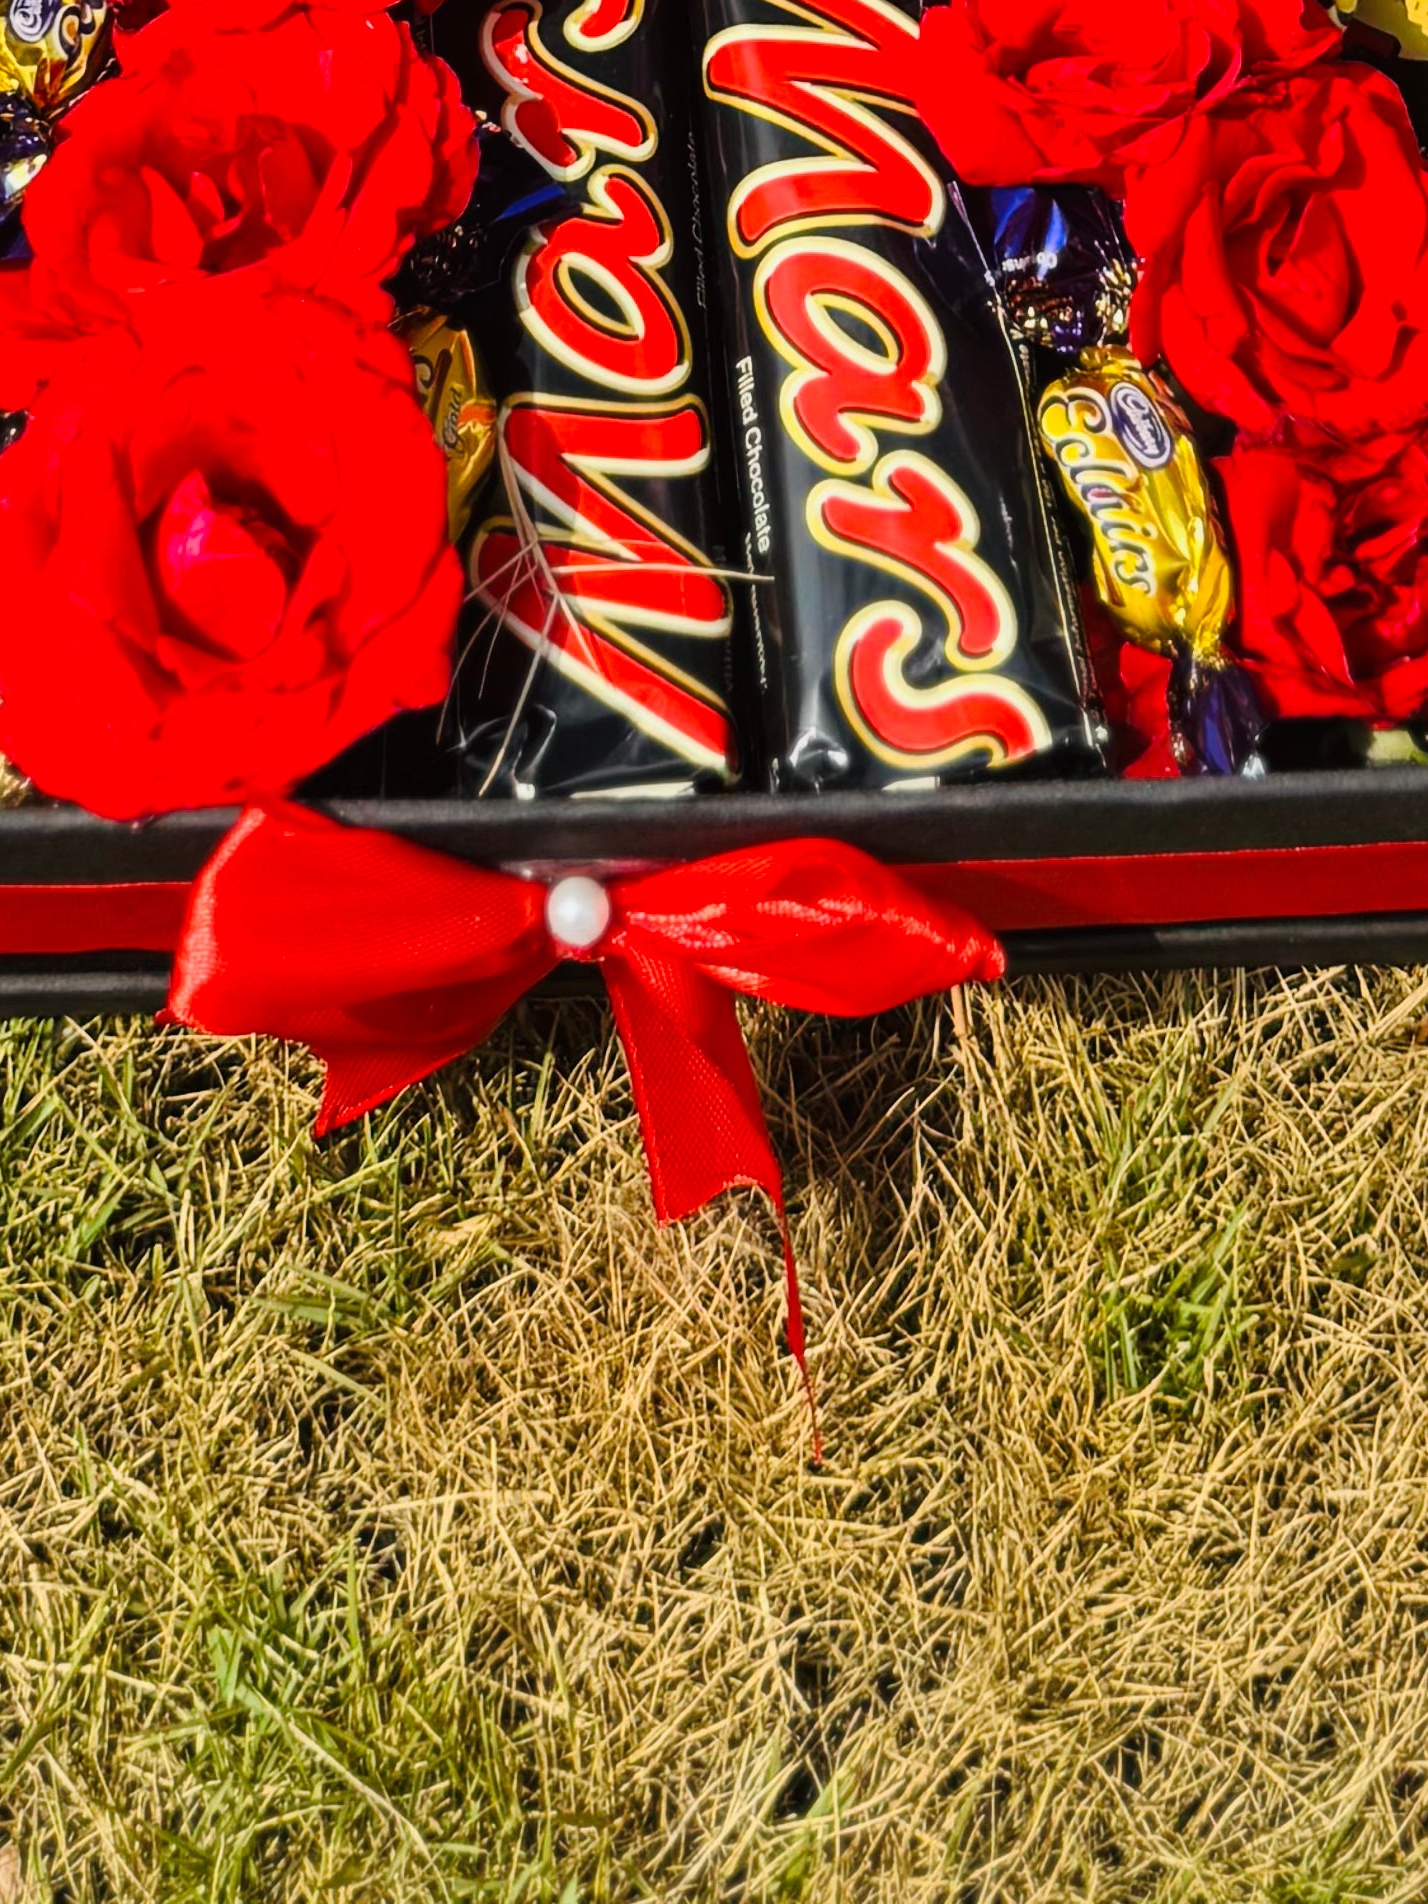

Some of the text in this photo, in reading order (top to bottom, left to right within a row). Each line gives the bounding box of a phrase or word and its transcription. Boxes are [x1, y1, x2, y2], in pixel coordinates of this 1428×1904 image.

[735, 354, 759, 422] Filled
[742, 424, 771, 554] Chocolate
[1038, 386, 1158, 599] Eclairs
